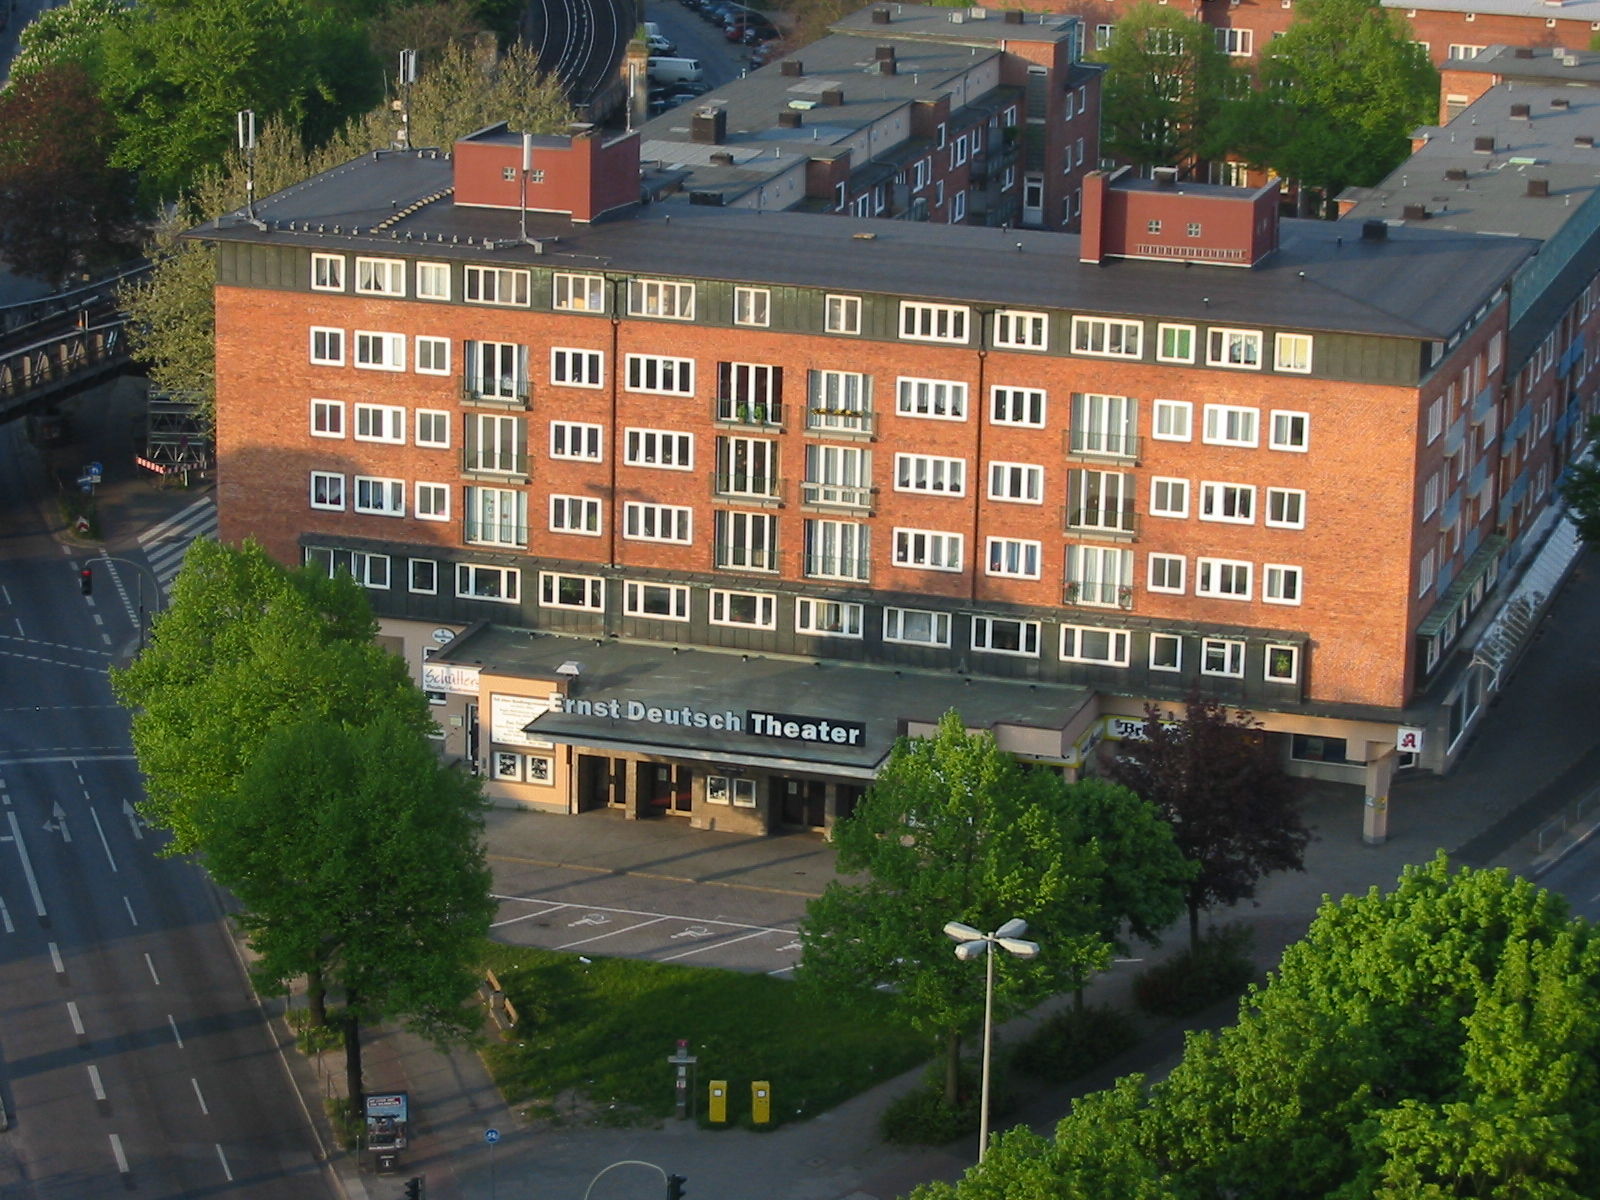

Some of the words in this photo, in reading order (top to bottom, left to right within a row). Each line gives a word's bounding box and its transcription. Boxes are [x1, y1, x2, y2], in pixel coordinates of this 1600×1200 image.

[549, 692, 621, 719] Ernst
[627, 700, 742, 732] Deutsch
[751, 713, 860, 744] Theater
